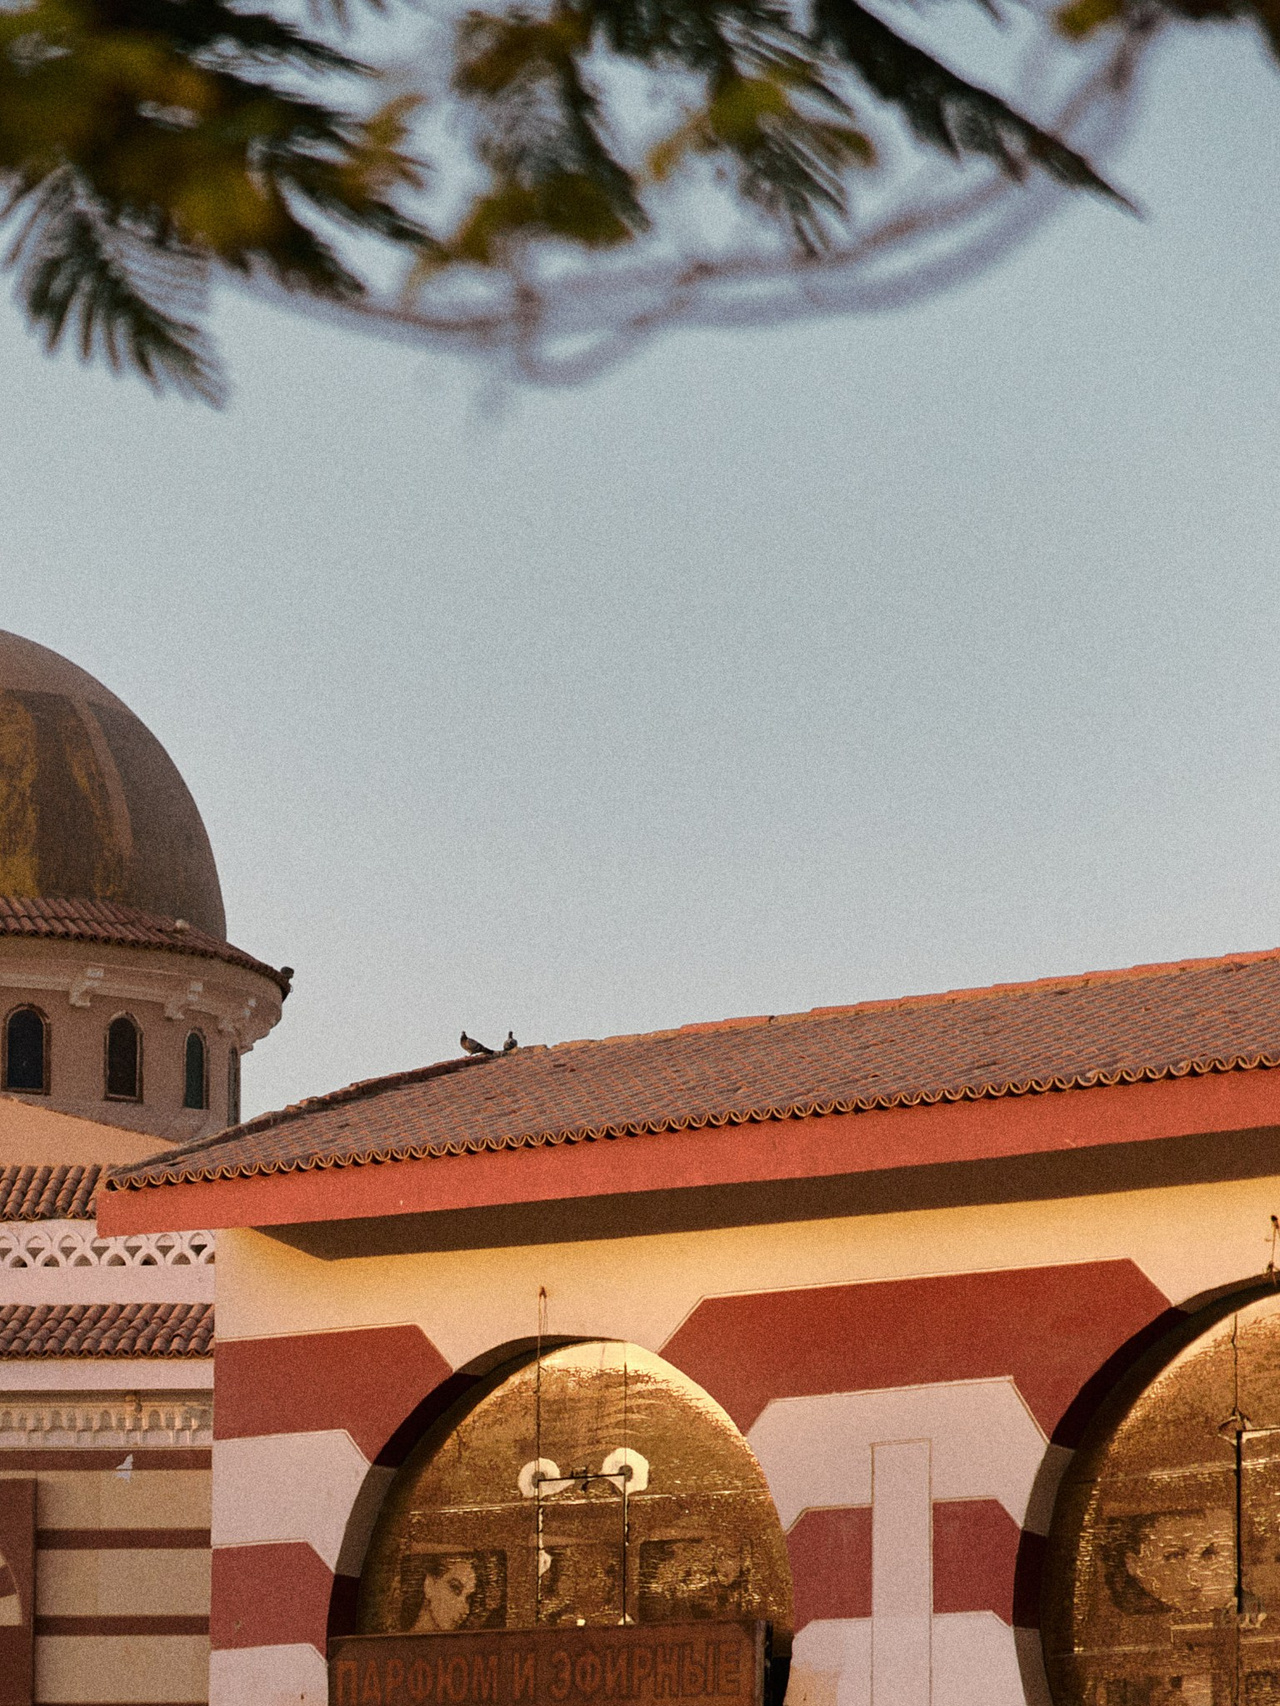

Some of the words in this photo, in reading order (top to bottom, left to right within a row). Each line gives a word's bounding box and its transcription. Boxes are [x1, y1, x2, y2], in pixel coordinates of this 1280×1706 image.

[335, 1654, 499, 1706] ПАРФЮМ
[512, 1651, 536, 1701] И
[549, 1640, 742, 1700] ЭФИРНЫЕ
